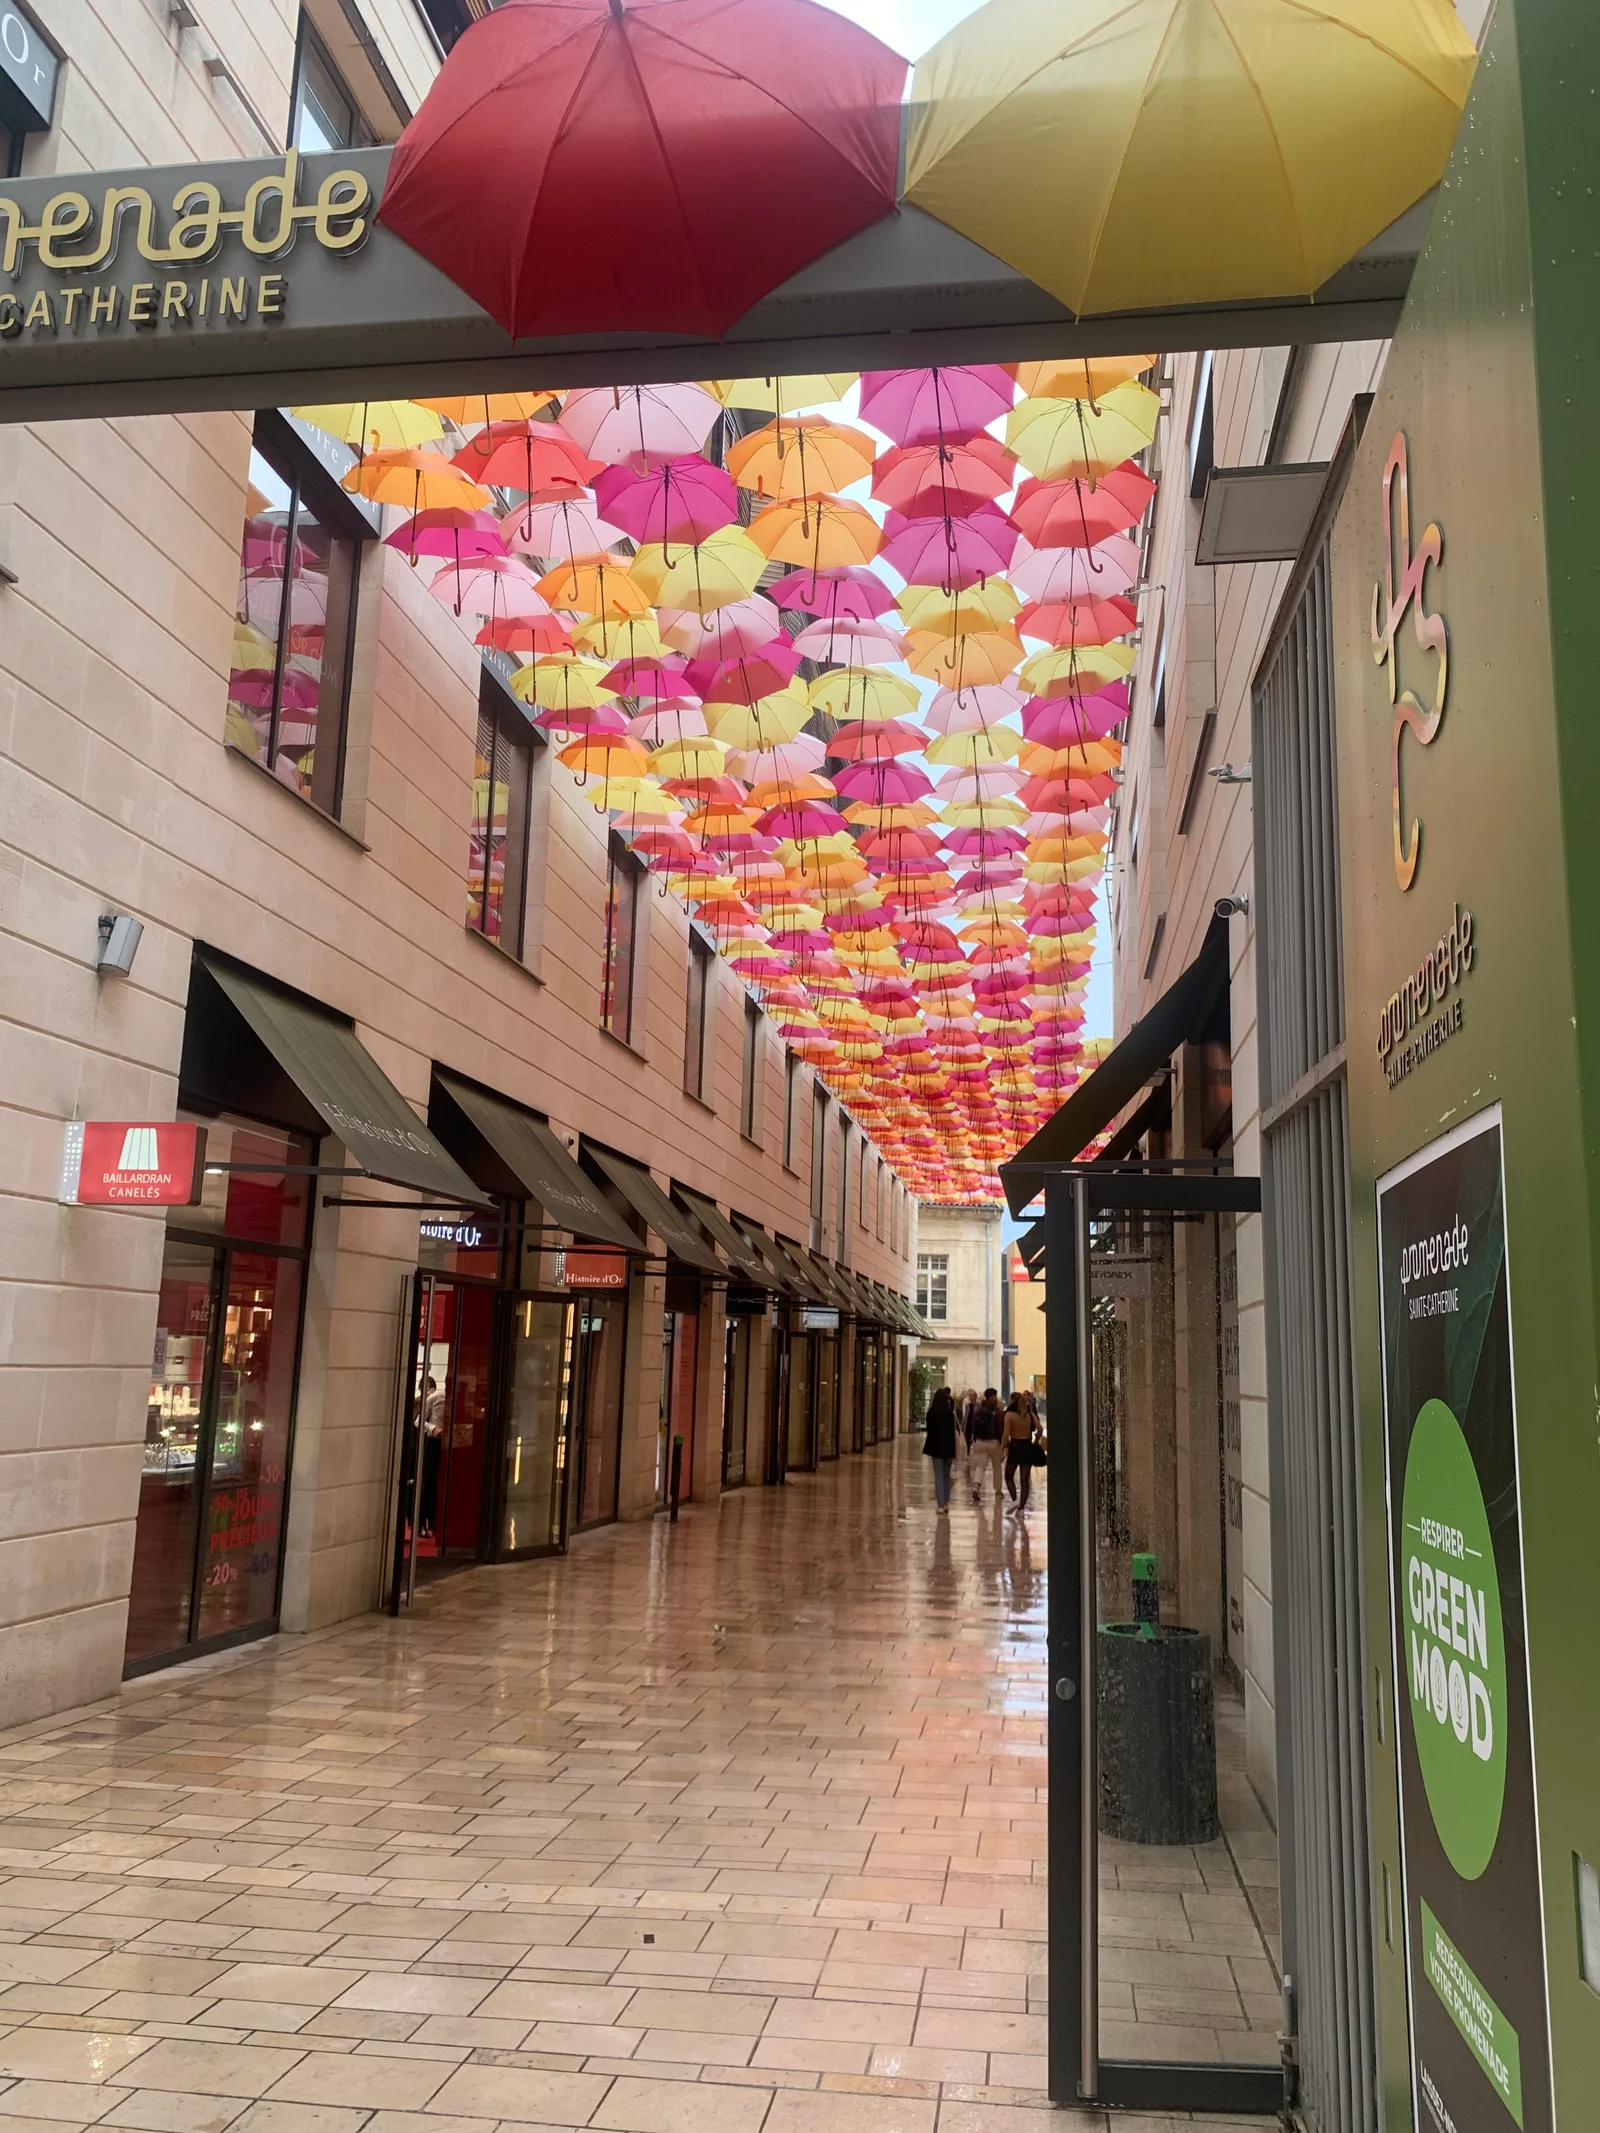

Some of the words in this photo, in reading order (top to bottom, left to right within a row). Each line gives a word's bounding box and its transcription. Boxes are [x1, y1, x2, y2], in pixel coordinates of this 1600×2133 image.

[102, 1173, 171, 1184] BAILLARDRAN
[108, 1186, 160, 1198] CANELÉS
[566, 1273, 600, 1284] Histoire
[602, 1274, 623, 1284] d'Or
[1409, 1288, 1459, 1320] SAINTE-CATHERINE
[1420, 1516, 1465, 1560] RESPIRER
[1408, 1555, 1488, 1670] GREEN
[1411, 1629, 1493, 1761] MOOD
[1429, 1950, 1453, 2007] VOTRE
[1454, 1989, 1510, 2096] PROMENADE
